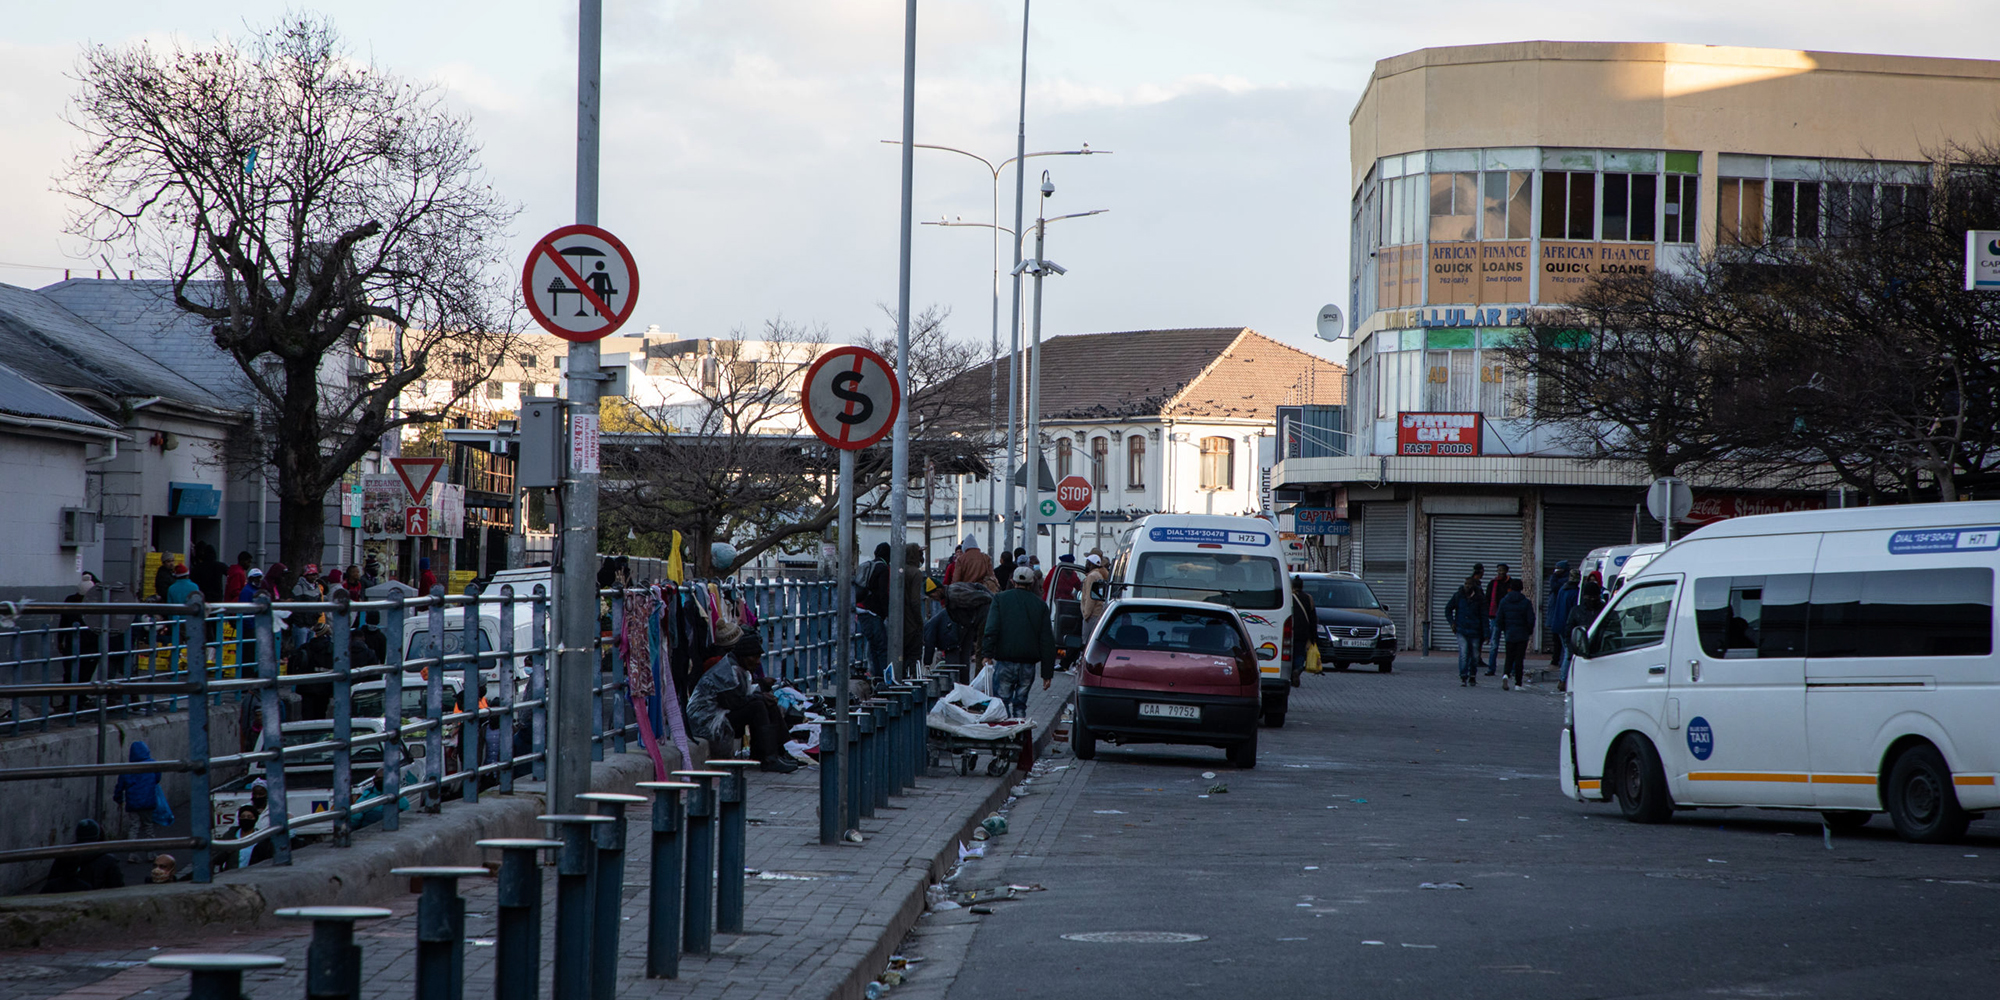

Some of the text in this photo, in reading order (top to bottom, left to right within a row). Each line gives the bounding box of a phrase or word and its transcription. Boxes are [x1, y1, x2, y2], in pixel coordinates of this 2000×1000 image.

[1432, 245, 1527, 259] AFRICAN FINANCE
[1543, 246, 1650, 261] AFRICAN FINANCE
[1434, 262, 1523, 273] QUICK LOANS
[1546, 262, 1647, 275] QUICK LOANS
[831, 370, 874, 425] S
[1403, 415, 1475, 428] STATION
[1417, 428, 1460, 441] CAFE
[1404, 443, 1473, 454] FAST FOODS
[1060, 486, 1089, 501] STOP
[1262, 466, 1271, 511] ATLANTIC
[1734, 498, 1780, 518] Station
[1298, 525, 1316, 533] FISH
[1318, 525, 1325, 533] &
[1238, 535, 1256, 543] H73
[1895, 534, 1913, 543] DIAL
[1969, 534, 1988, 545] H71
[1144, 704, 1195, 718] CAA 79752
[1690, 732, 1710, 743] TAXI
